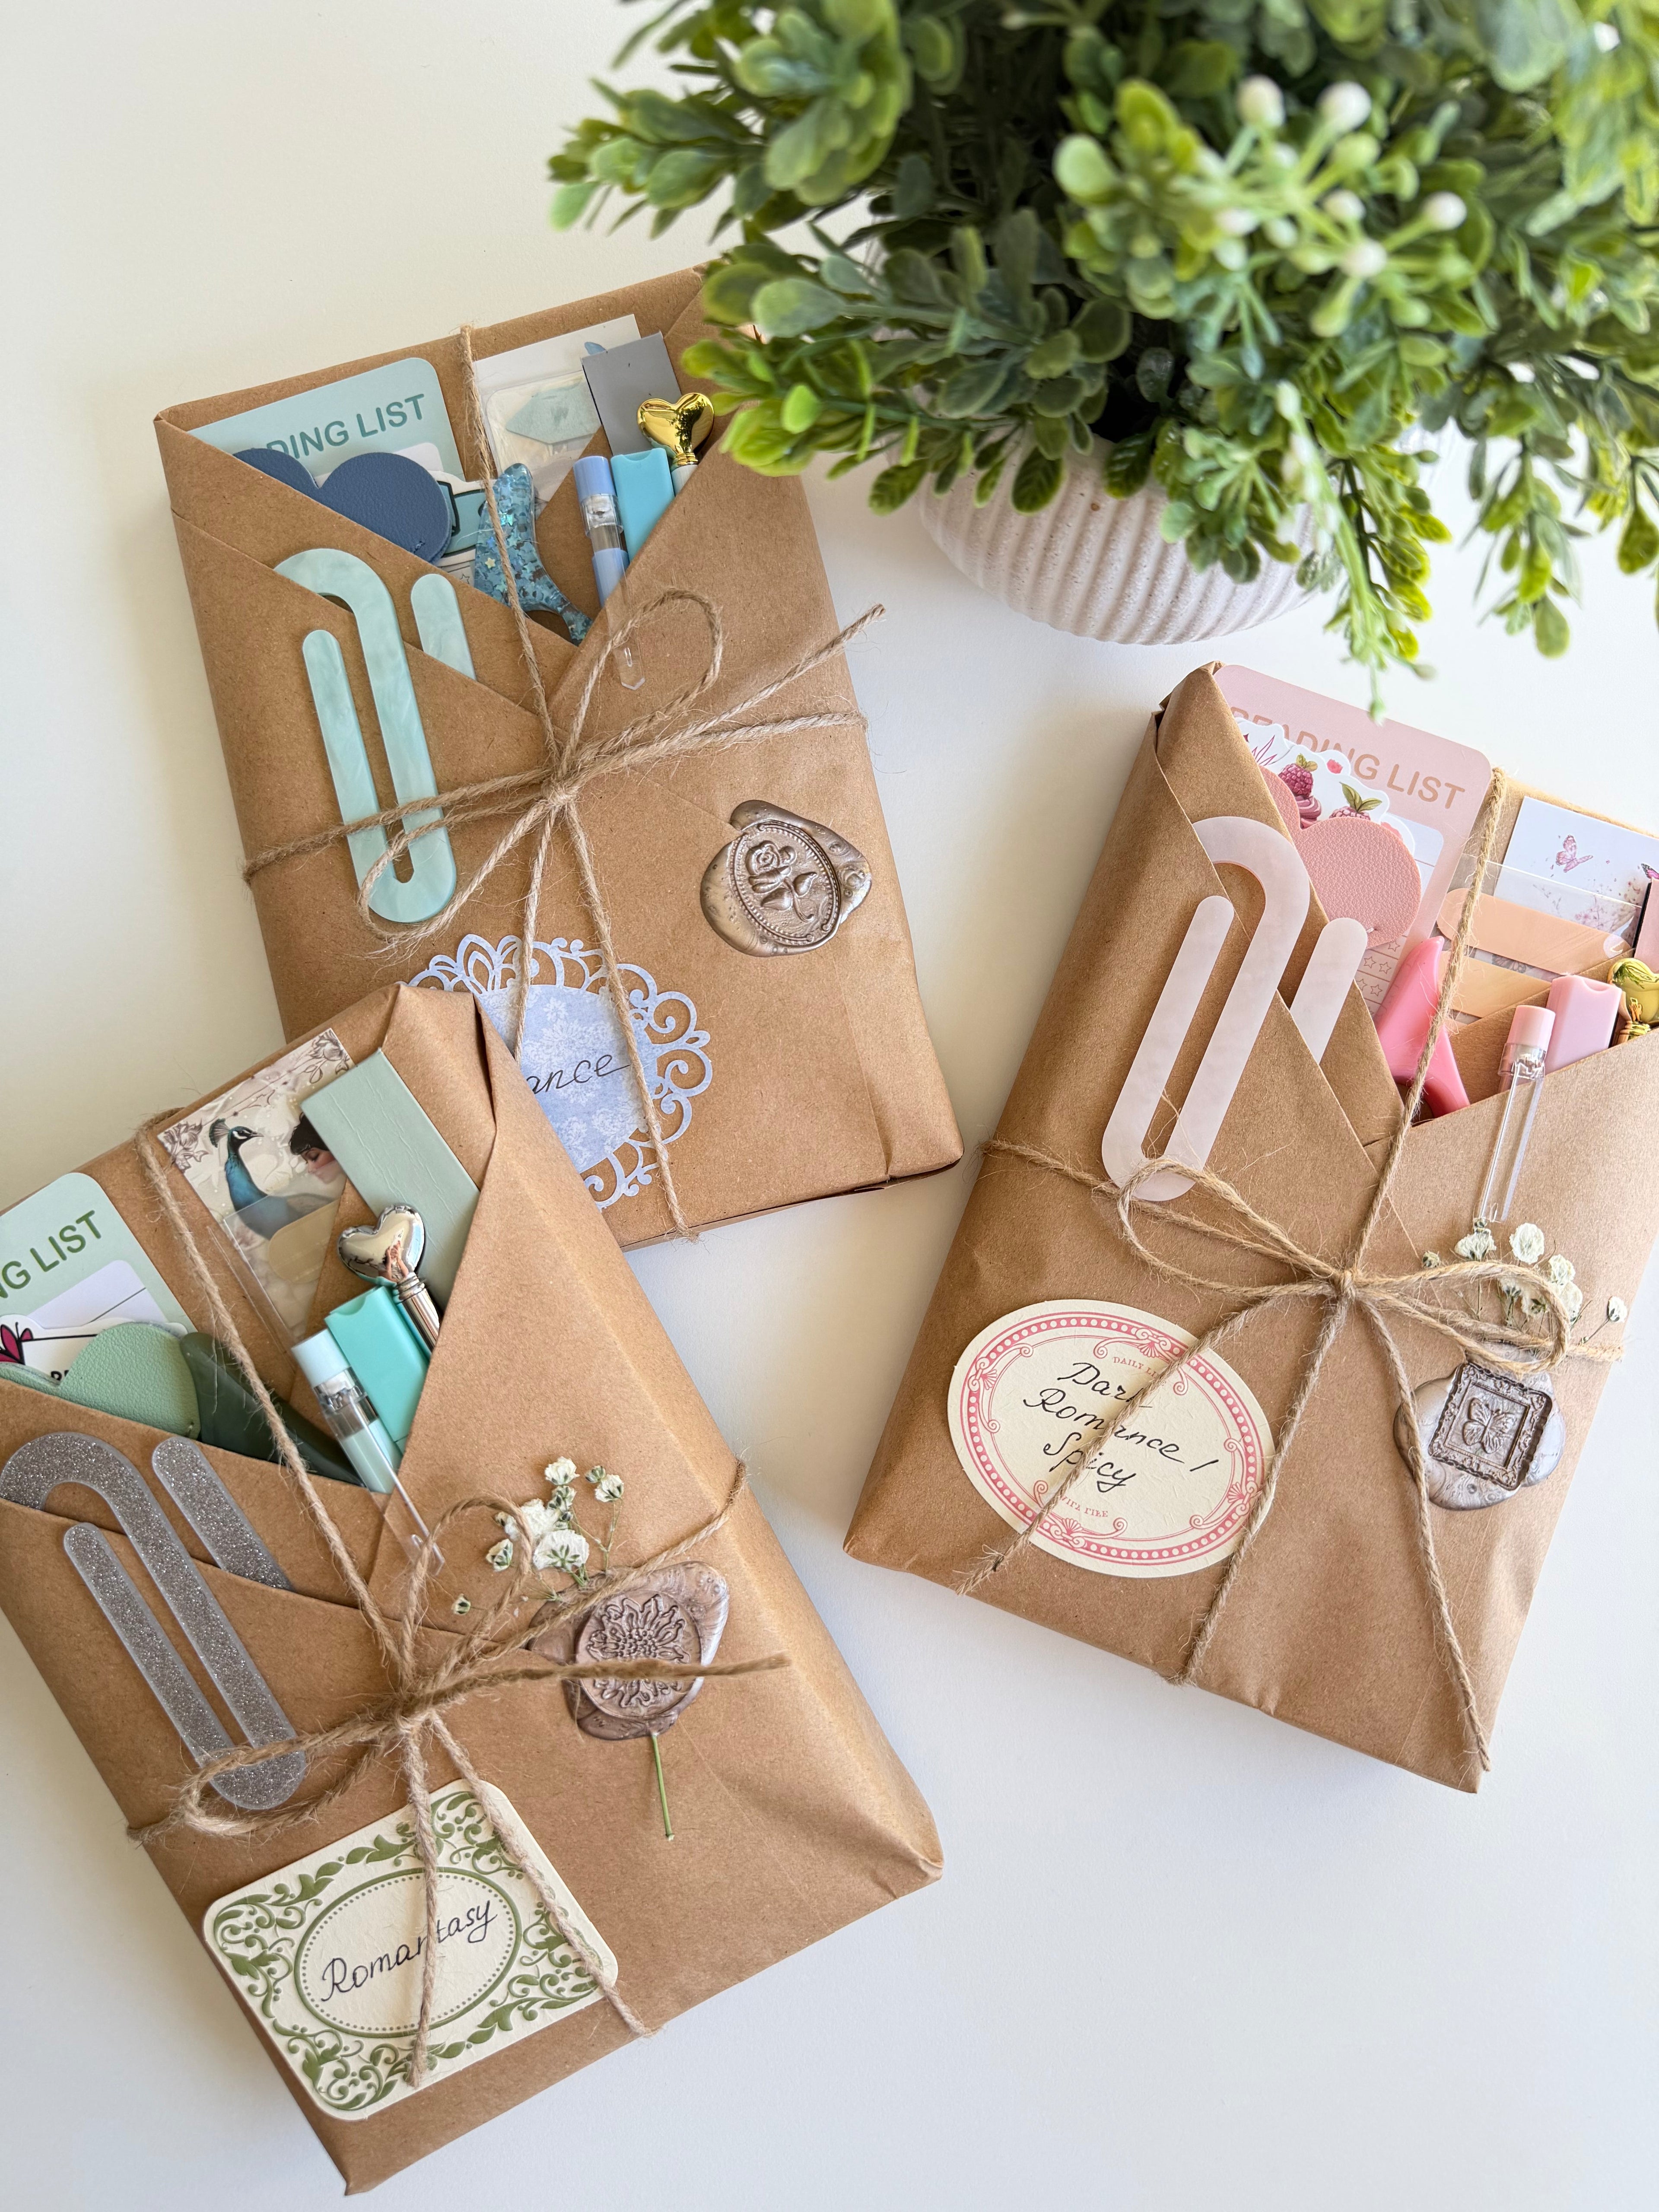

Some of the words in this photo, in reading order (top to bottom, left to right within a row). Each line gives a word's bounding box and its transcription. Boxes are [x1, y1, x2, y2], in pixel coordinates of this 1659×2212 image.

[356, 393, 425, 438] LIST
[1386, 763, 1465, 809] LIST
[526, 1054, 630, 1094] ance
[30, 1210, 102, 1272] LIST
[1113, 1357, 1144, 1370] DAILY
